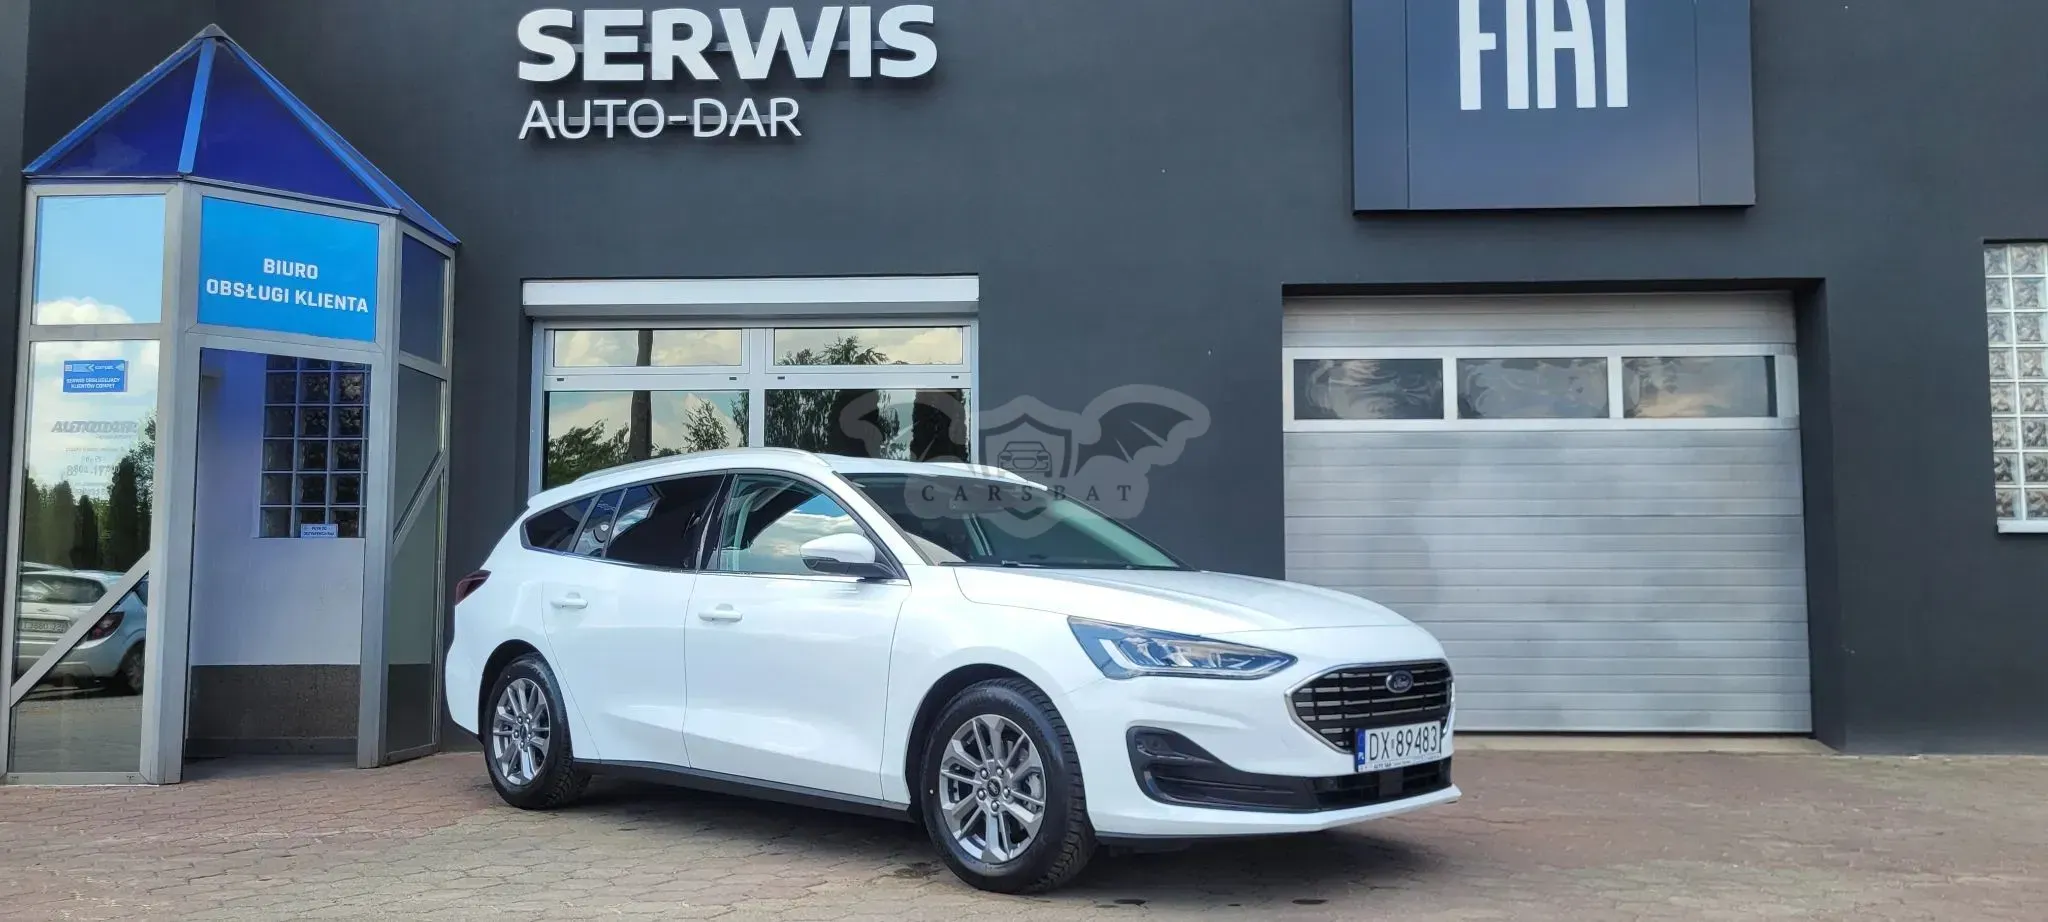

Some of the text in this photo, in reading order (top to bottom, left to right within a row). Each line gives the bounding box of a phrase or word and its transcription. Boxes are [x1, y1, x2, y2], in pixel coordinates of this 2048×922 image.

[517, 5, 938, 81] SERWIS
[1459, 0, 1628, 110] FIAT
[519, 97, 801, 139] AUTO-DAR
[263, 258, 319, 280] BIURO
[206, 278, 369, 313] OBSŁUGI KLIENTA
[1370, 726, 1437, 760] DX 89483
